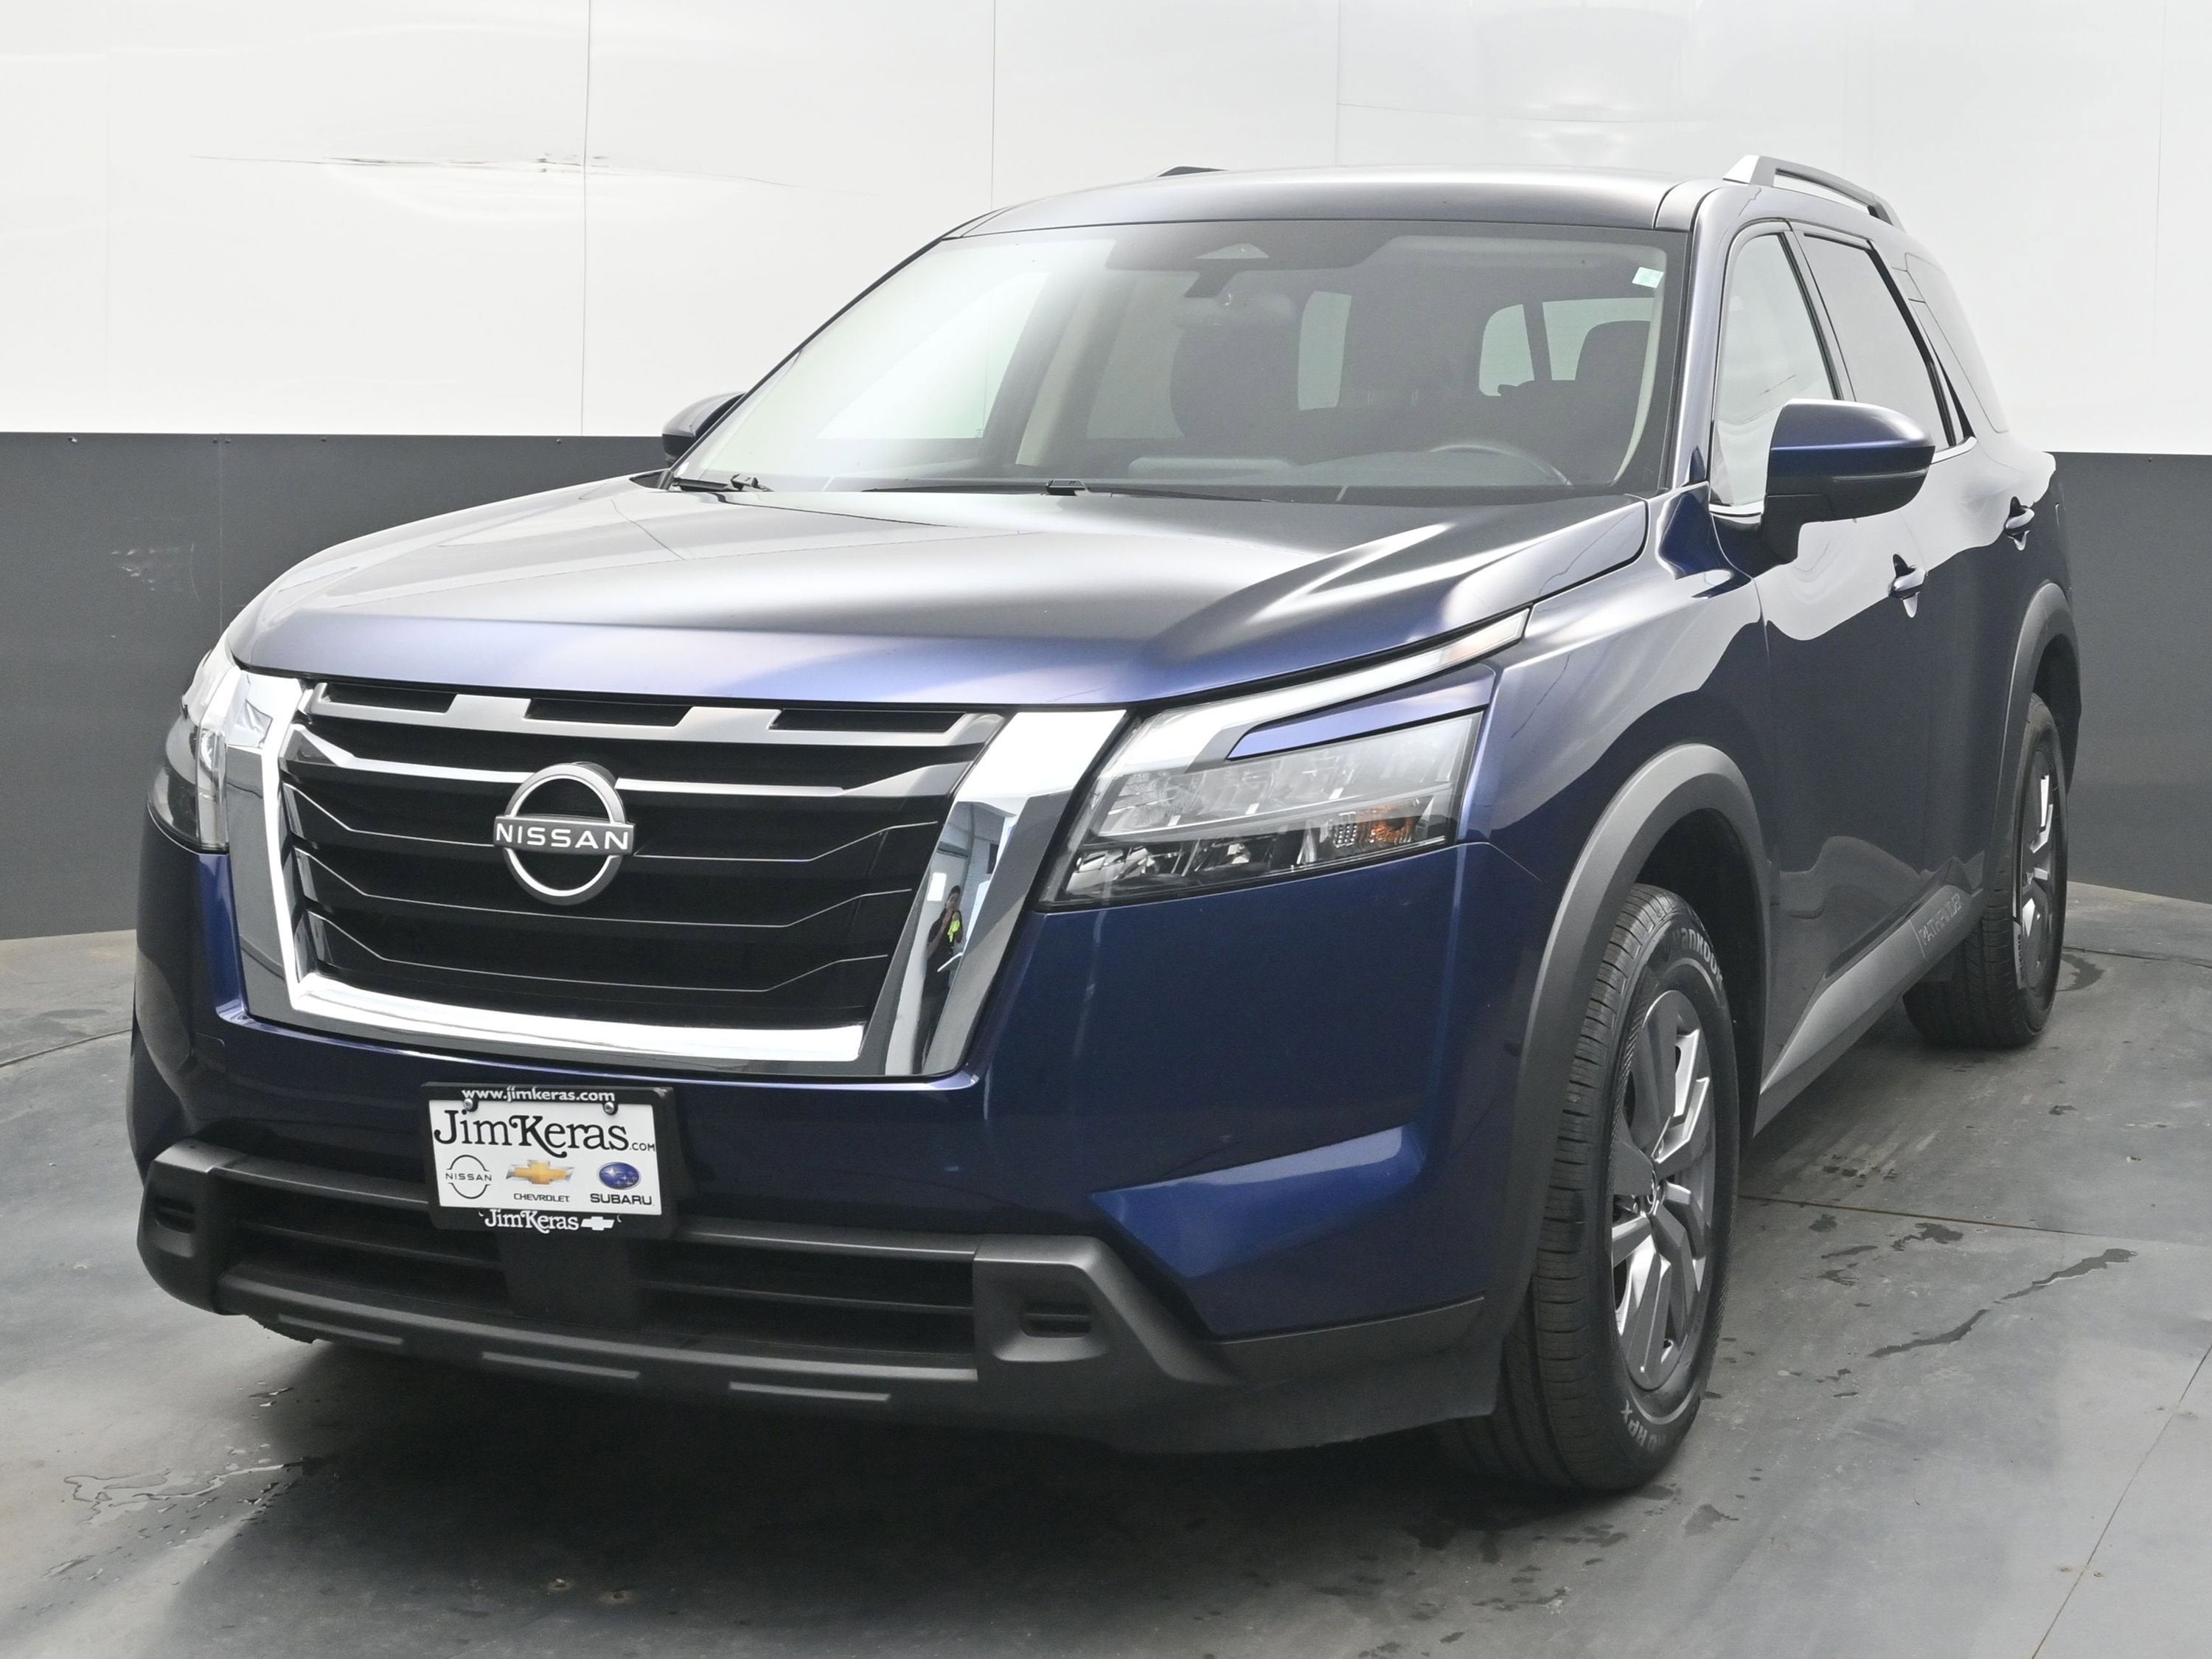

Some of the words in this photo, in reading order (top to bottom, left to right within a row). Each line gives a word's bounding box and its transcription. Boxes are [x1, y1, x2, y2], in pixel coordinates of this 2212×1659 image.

[495, 823, 629, 850] NISSAN
[461, 1085, 616, 1103] www.jimkeras.com
[445, 1172, 493, 1182] NISSAN
[513, 1192, 571, 1203] CHEVROLET
[590, 1192, 653, 1206] SUBARU
